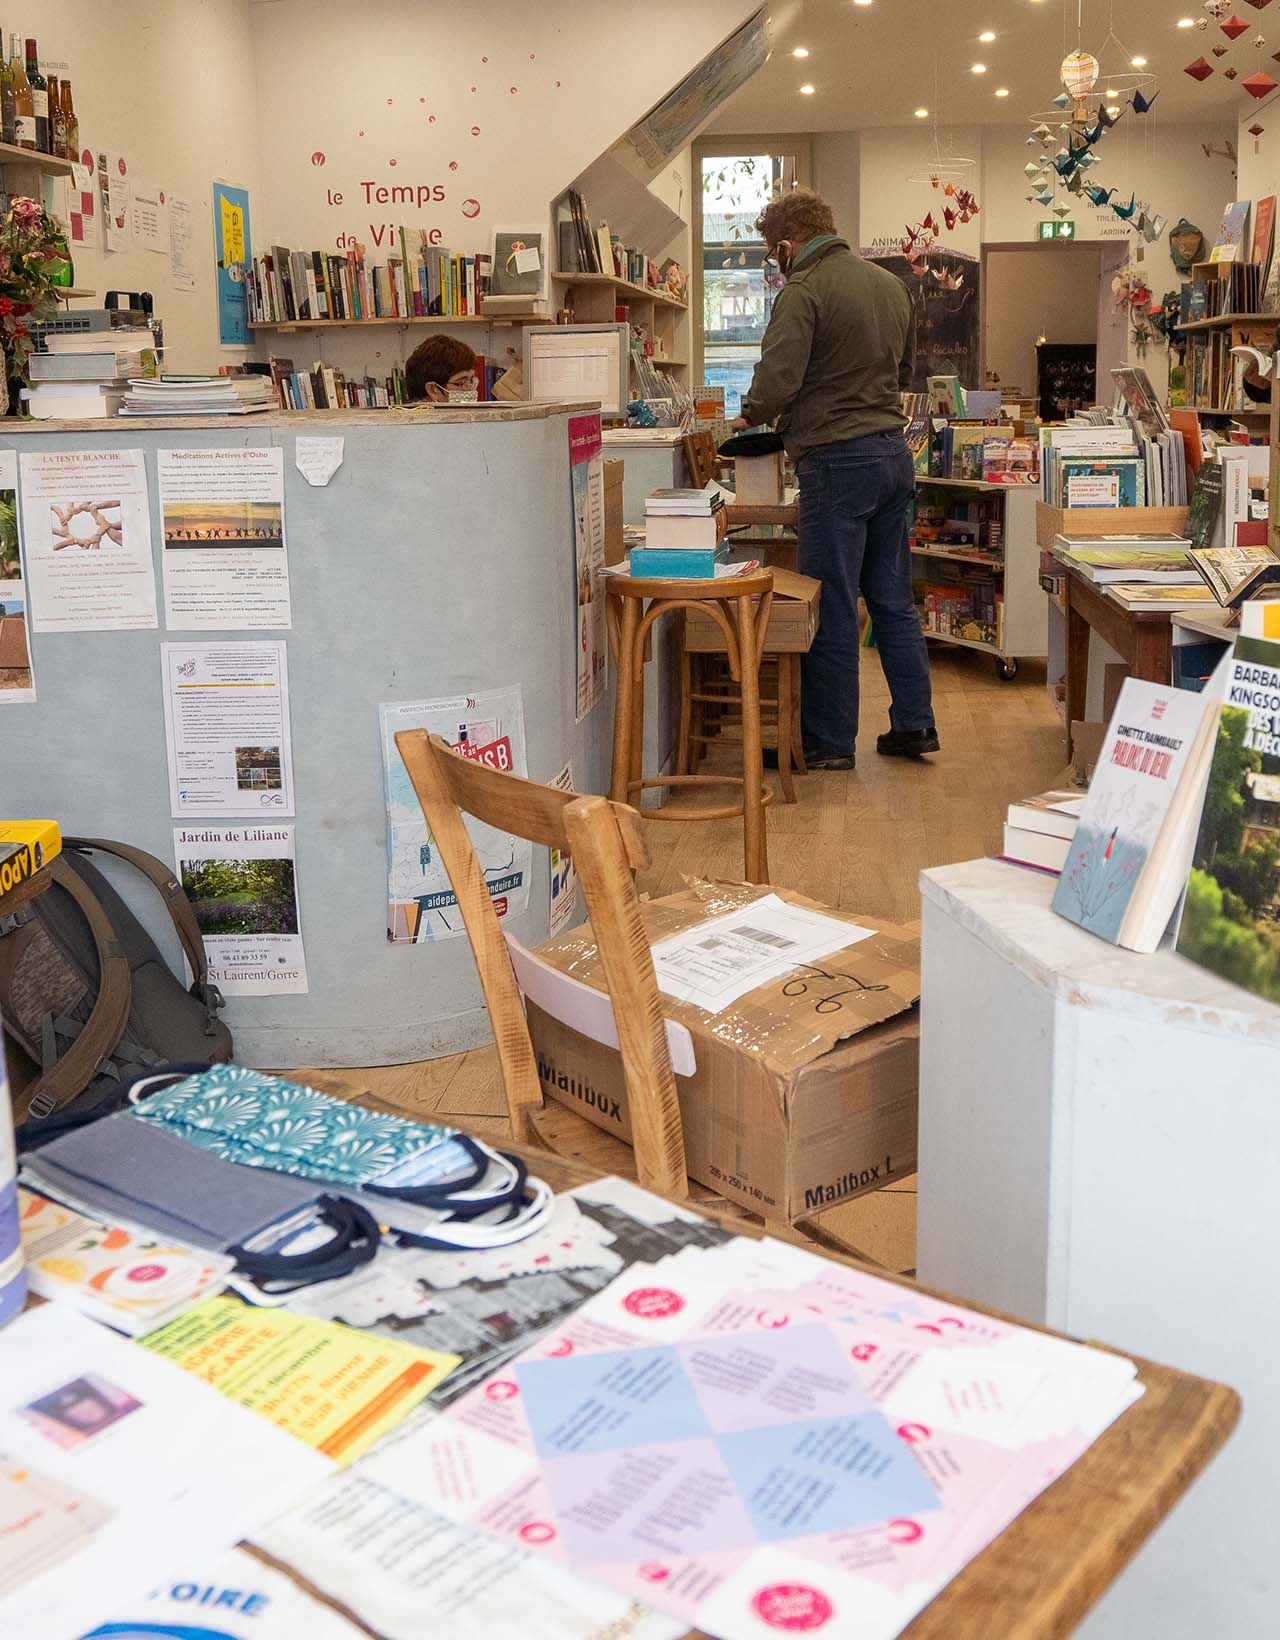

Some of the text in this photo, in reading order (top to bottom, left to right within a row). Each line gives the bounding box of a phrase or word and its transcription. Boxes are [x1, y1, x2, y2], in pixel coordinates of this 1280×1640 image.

[327, 182, 445, 208] le Temps
[1100, 228, 1125, 236] JARDIN
[55, 454, 81, 463] TENTE
[83, 453, 121, 462] BLANCHE
[1247, 710, 1272, 733] DES
[1117, 724, 1184, 752] GINETTE RAIMBAULT
[498, 744, 509, 770] B
[180, 830, 288, 843] Jardin de Liliane
[209, 969, 299, 982] St Laurent/Gorre
[805, 1156, 895, 1209] Mailbox L
